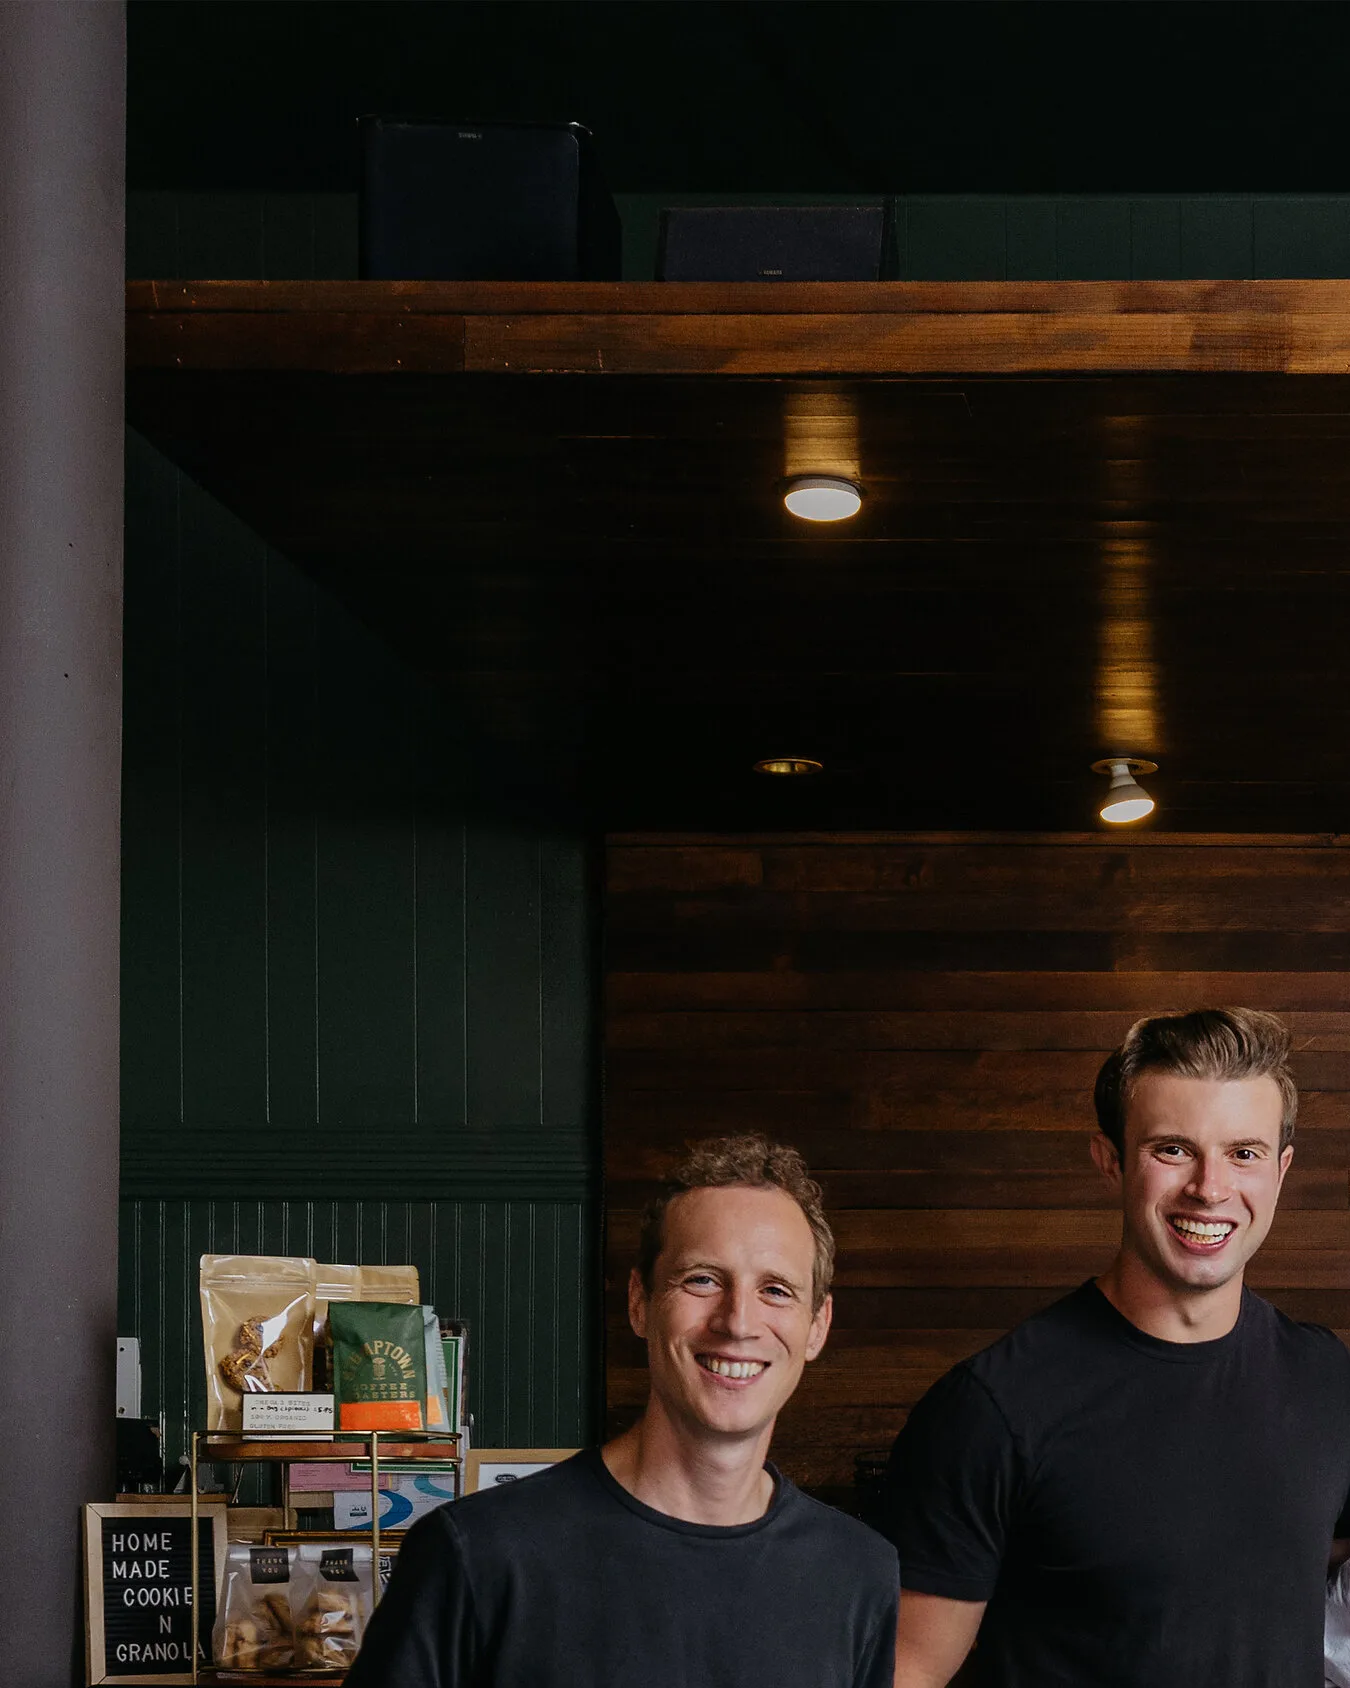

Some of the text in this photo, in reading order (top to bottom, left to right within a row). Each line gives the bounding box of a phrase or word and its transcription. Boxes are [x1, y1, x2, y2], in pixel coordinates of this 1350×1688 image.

[112, 1532, 172, 1552] HOME
[112, 1560, 170, 1579] MADE
[325, 1559, 349, 1567] THANK
[159, 1615, 172, 1634] N
